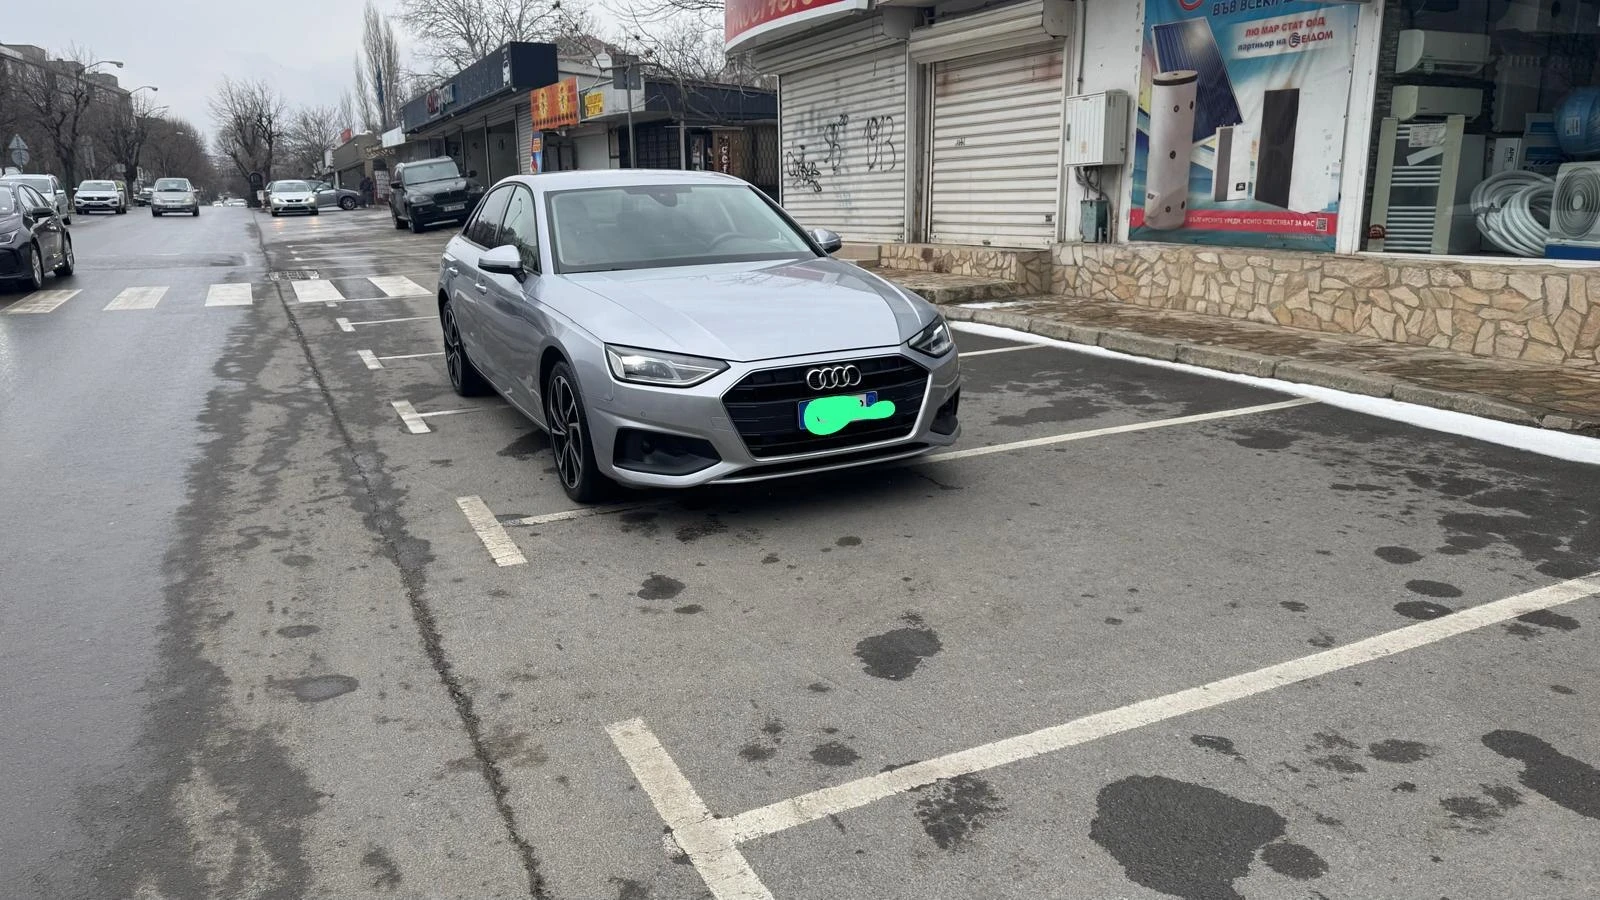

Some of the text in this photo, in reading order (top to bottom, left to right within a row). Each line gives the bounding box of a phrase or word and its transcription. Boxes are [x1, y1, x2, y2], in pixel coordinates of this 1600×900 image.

[1212, 1, 1237, 16] ВЪВ
[1238, 40, 1274, 52] партньор
[1276, 38, 1287, 46] на
[1303, 220, 1315, 228] ВАС
